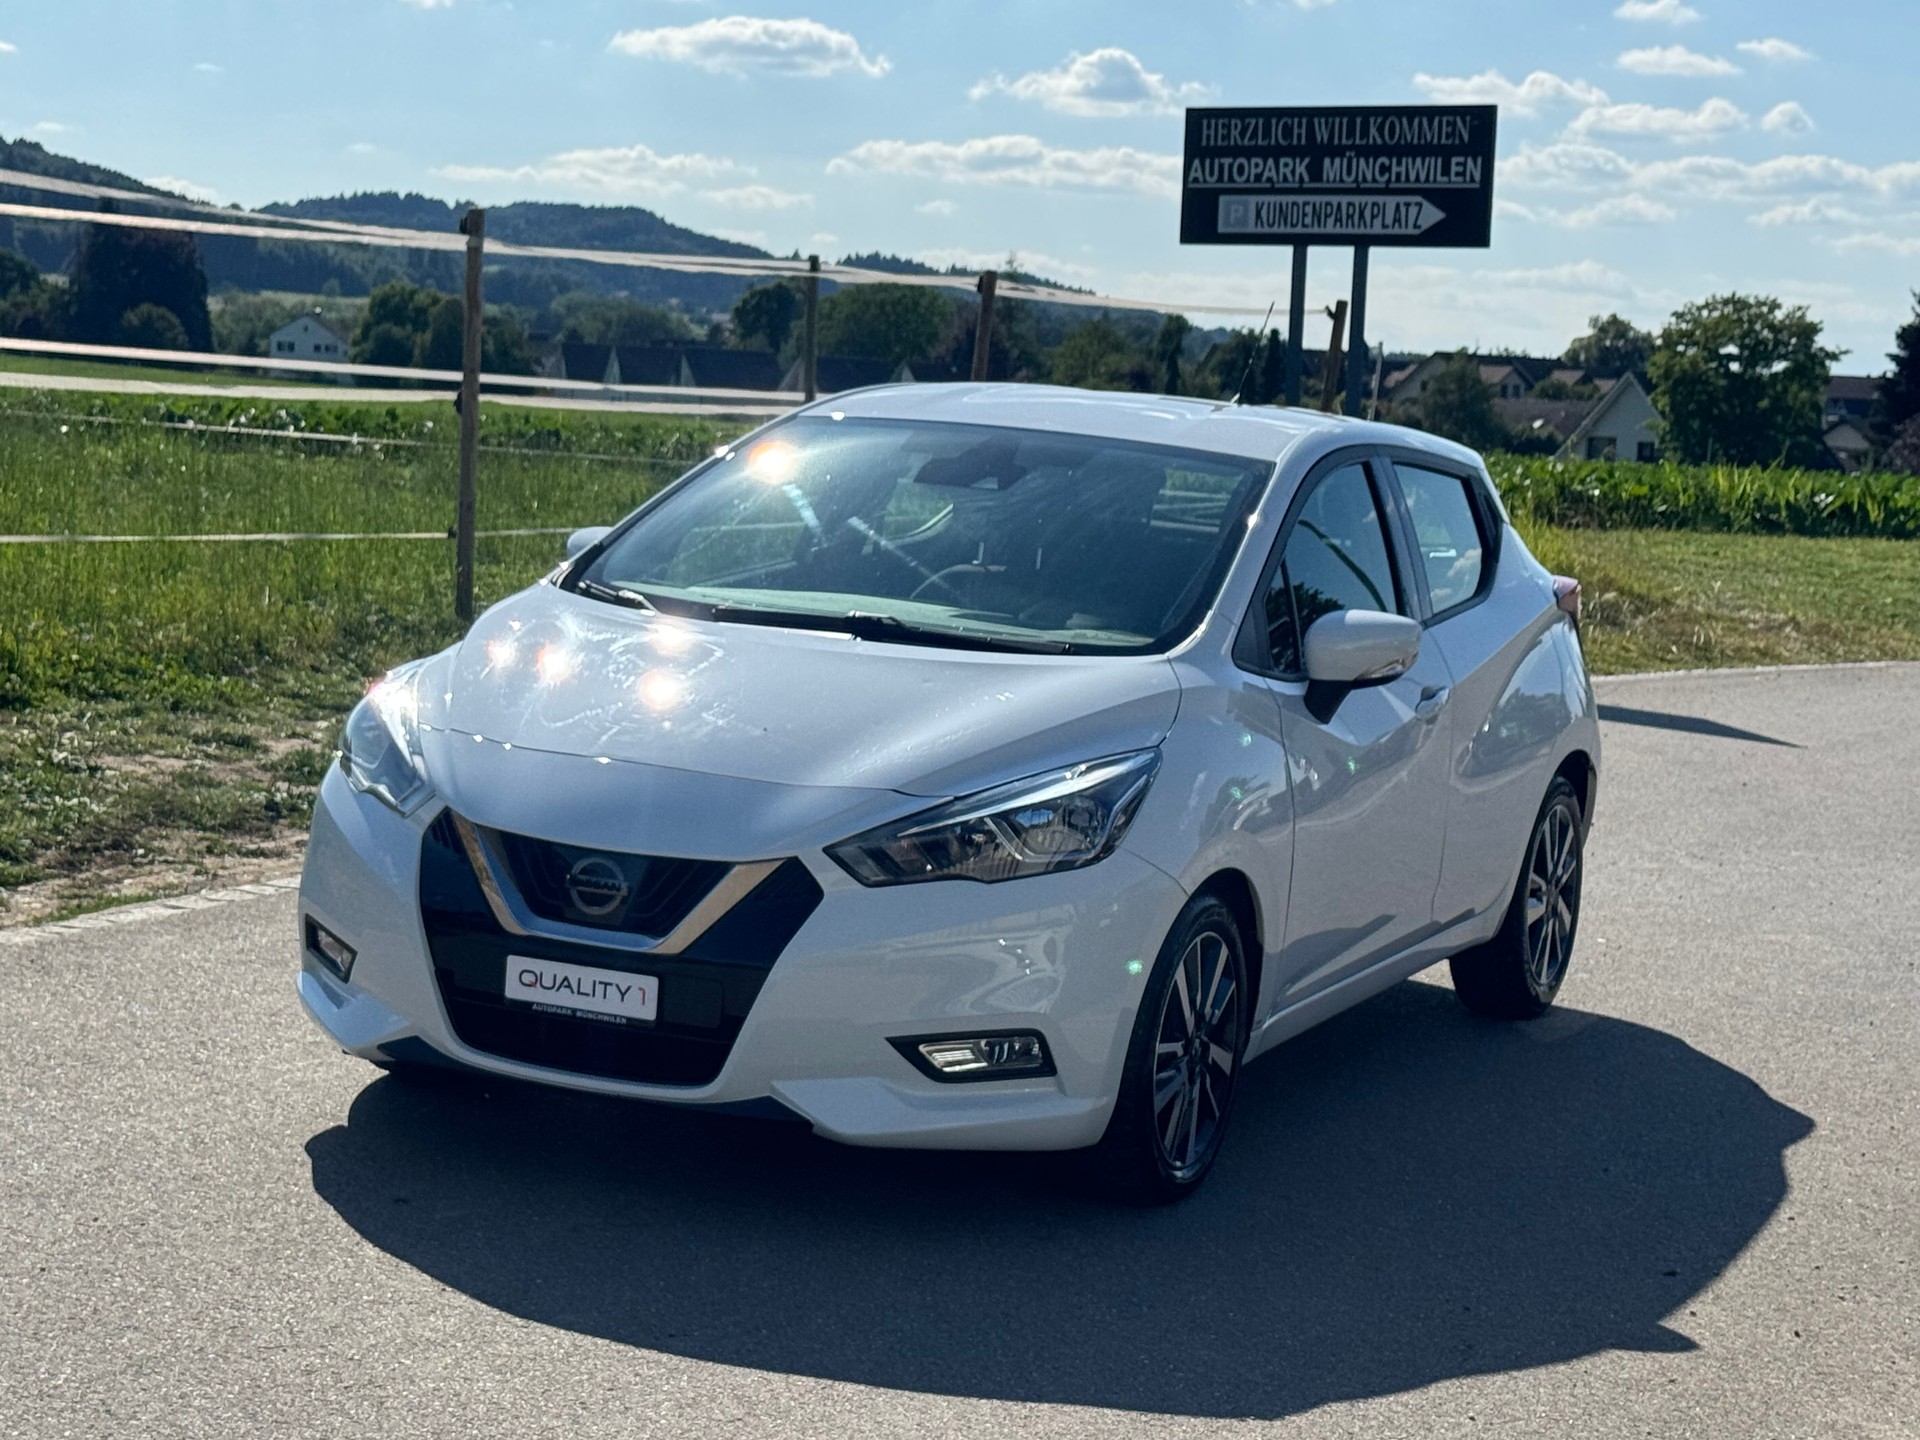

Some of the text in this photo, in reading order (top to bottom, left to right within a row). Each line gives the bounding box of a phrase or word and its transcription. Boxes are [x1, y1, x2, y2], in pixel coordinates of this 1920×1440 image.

[1201, 115, 1472, 147] HERZLICH WILLKOMMEN
[1188, 152, 1482, 183] AUTOPARK MÜNCHWILEN
[1254, 200, 1424, 230] KUNDENPARKPLATZ
[518, 969, 632, 1002] QUALITY
[532, 1003, 573, 1016] AUTOPARK
